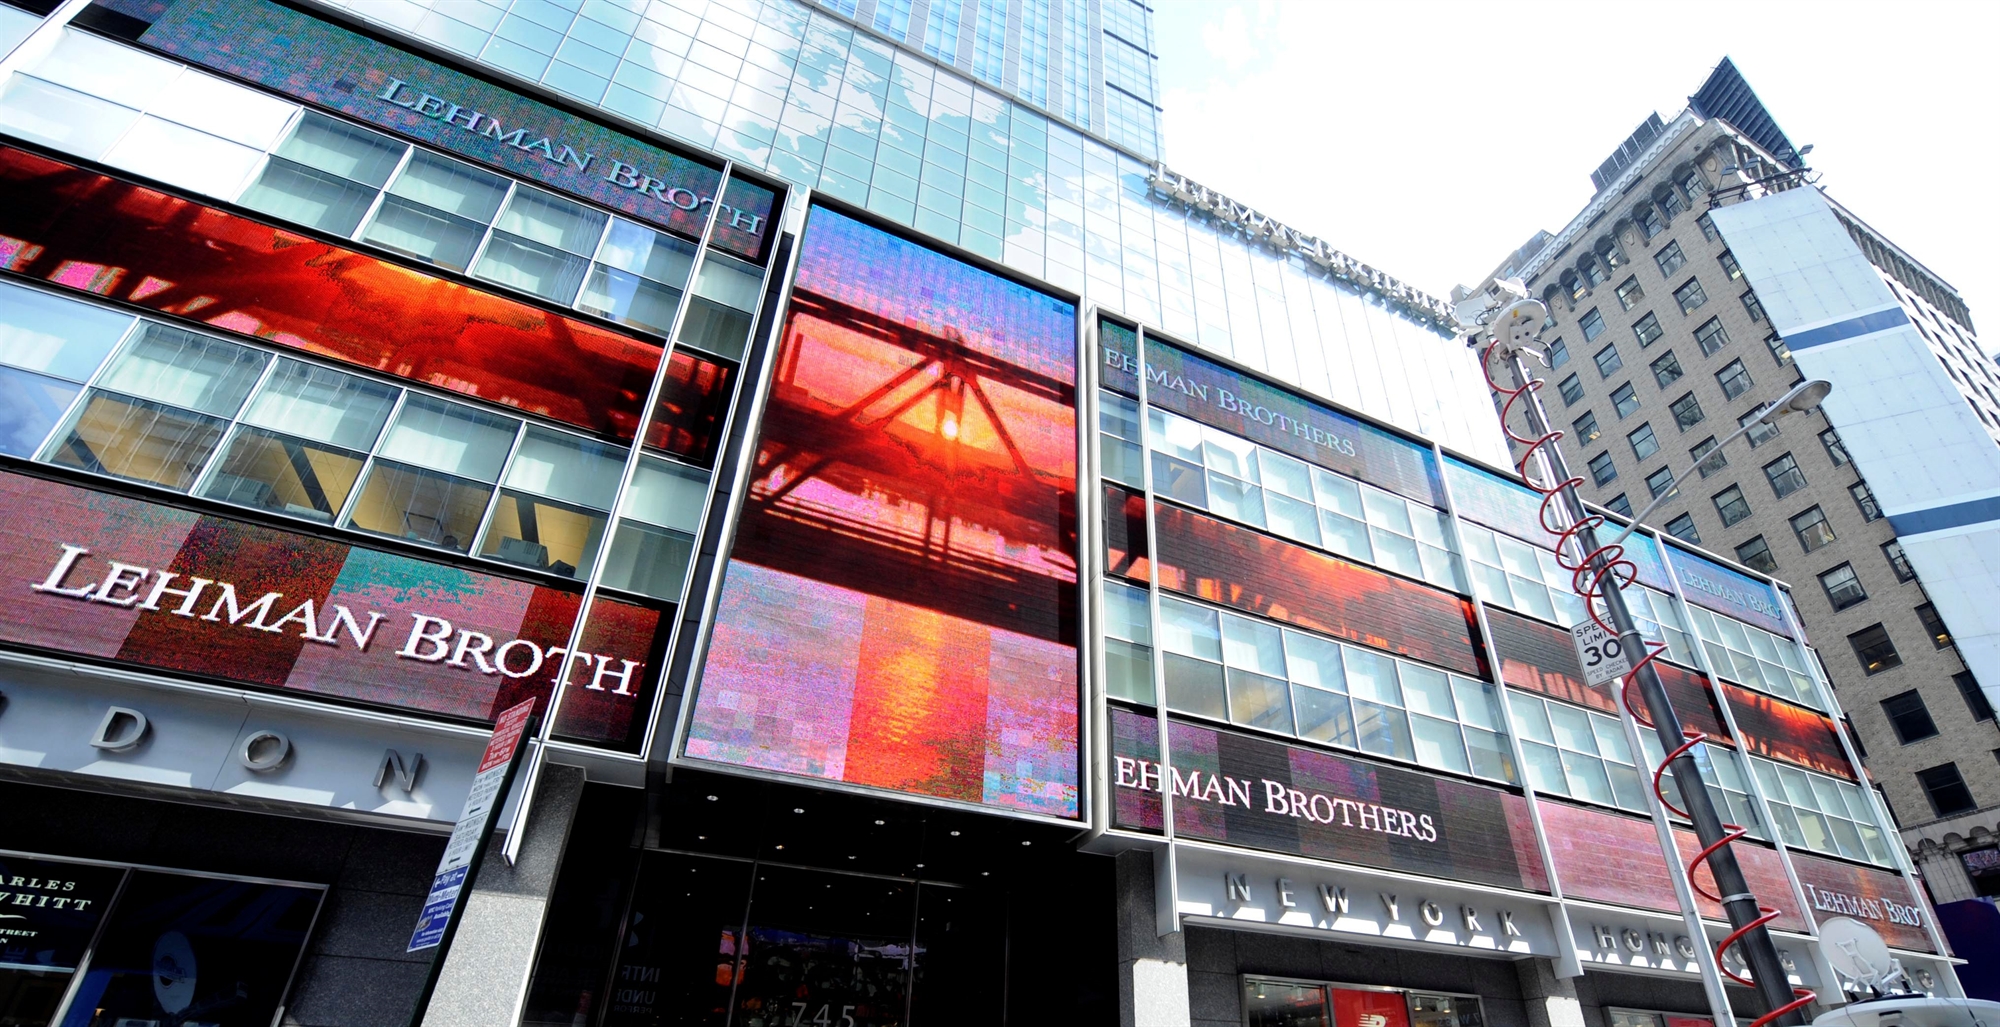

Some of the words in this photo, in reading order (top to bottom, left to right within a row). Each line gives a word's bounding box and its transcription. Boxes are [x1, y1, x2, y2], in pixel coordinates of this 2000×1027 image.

[377, 77, 594, 174] LEHMAN
[603, 158, 763, 237] BROTH
[1104, 347, 1208, 402] EHMAN
[1216, 387, 1356, 458] BROTHERS
[1677, 566, 1749, 609] LEHMAN
[1746, 592, 1782, 620] BRO
[31, 542, 388, 651] LEHMAN
[394, 612, 645, 697] BROTH
[1583, 627, 1612, 646] LIMI
[1584, 638, 1622, 667] 30
[1587, 667, 1604, 677] SPEED
[1605, 665, 1624, 675] RADAR
[1115, 755, 1252, 809] EHMAN
[1261, 778, 1437, 843] BROTHERS
[1225, 872, 1349, 914] NEW
[1381, 892, 1521, 937] YORK
[1806, 883, 1885, 920] LEHMAN
[1881, 897, 1921, 927] BRO
[1592, 925, 1696, 960] HONG
[791, 1002, 855, 1027] 745
